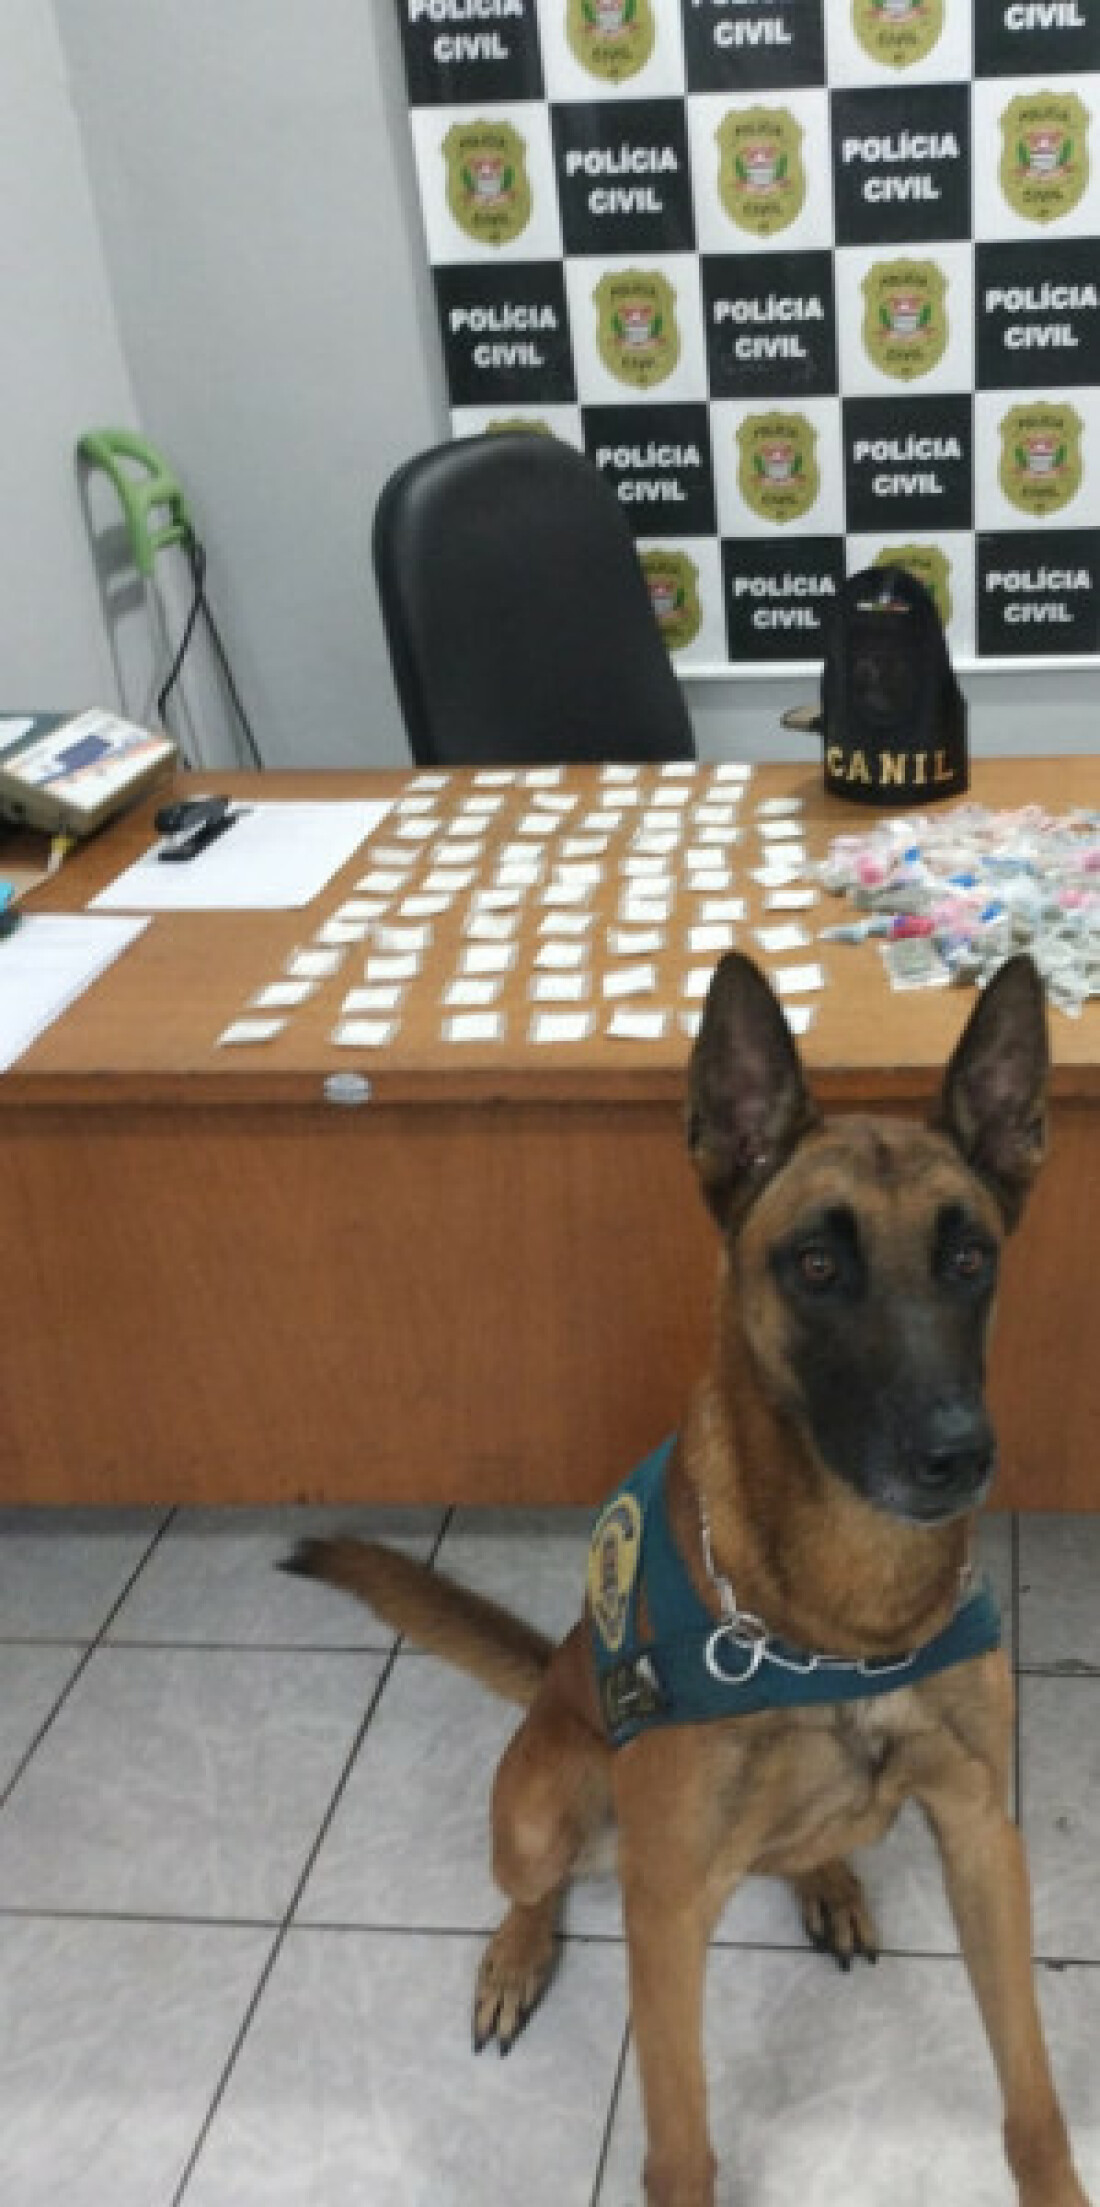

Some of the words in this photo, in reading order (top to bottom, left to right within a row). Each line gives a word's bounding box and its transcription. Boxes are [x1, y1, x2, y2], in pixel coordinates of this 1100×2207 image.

[1004, 0, 1086, 30] CIVIL
[712, 14, 791, 47] CIVIL
[434, 33, 508, 63] CIVIL
[842, 129, 960, 162] POLÍCIA
[566, 144, 677, 176] POLÍCIA
[588, 187, 662, 214] CIVIL
[861, 173, 942, 202] CIVIL
[714, 294, 824, 323] POLÍCIA
[986, 282, 1100, 313] POLÍCIA
[449, 305, 556, 331] POLÍCIA
[735, 335, 806, 360] CIVIL
[1004, 324, 1078, 349] CIVIL
[474, 342, 544, 368] CIVIL
[596, 442, 699, 468] POLÍCIA
[853, 434, 961, 460] POLÍCIA
[618, 479, 685, 501] CIVIL
[872, 471, 942, 496] CIVIL
[733, 574, 835, 596] POLÍCIA
[986, 567, 1092, 592] POLÍCIA
[754, 607, 820, 629] CIVIL
[1004, 603, 1072, 622] CIVIL
[829, 746, 954, 784] CANIL
